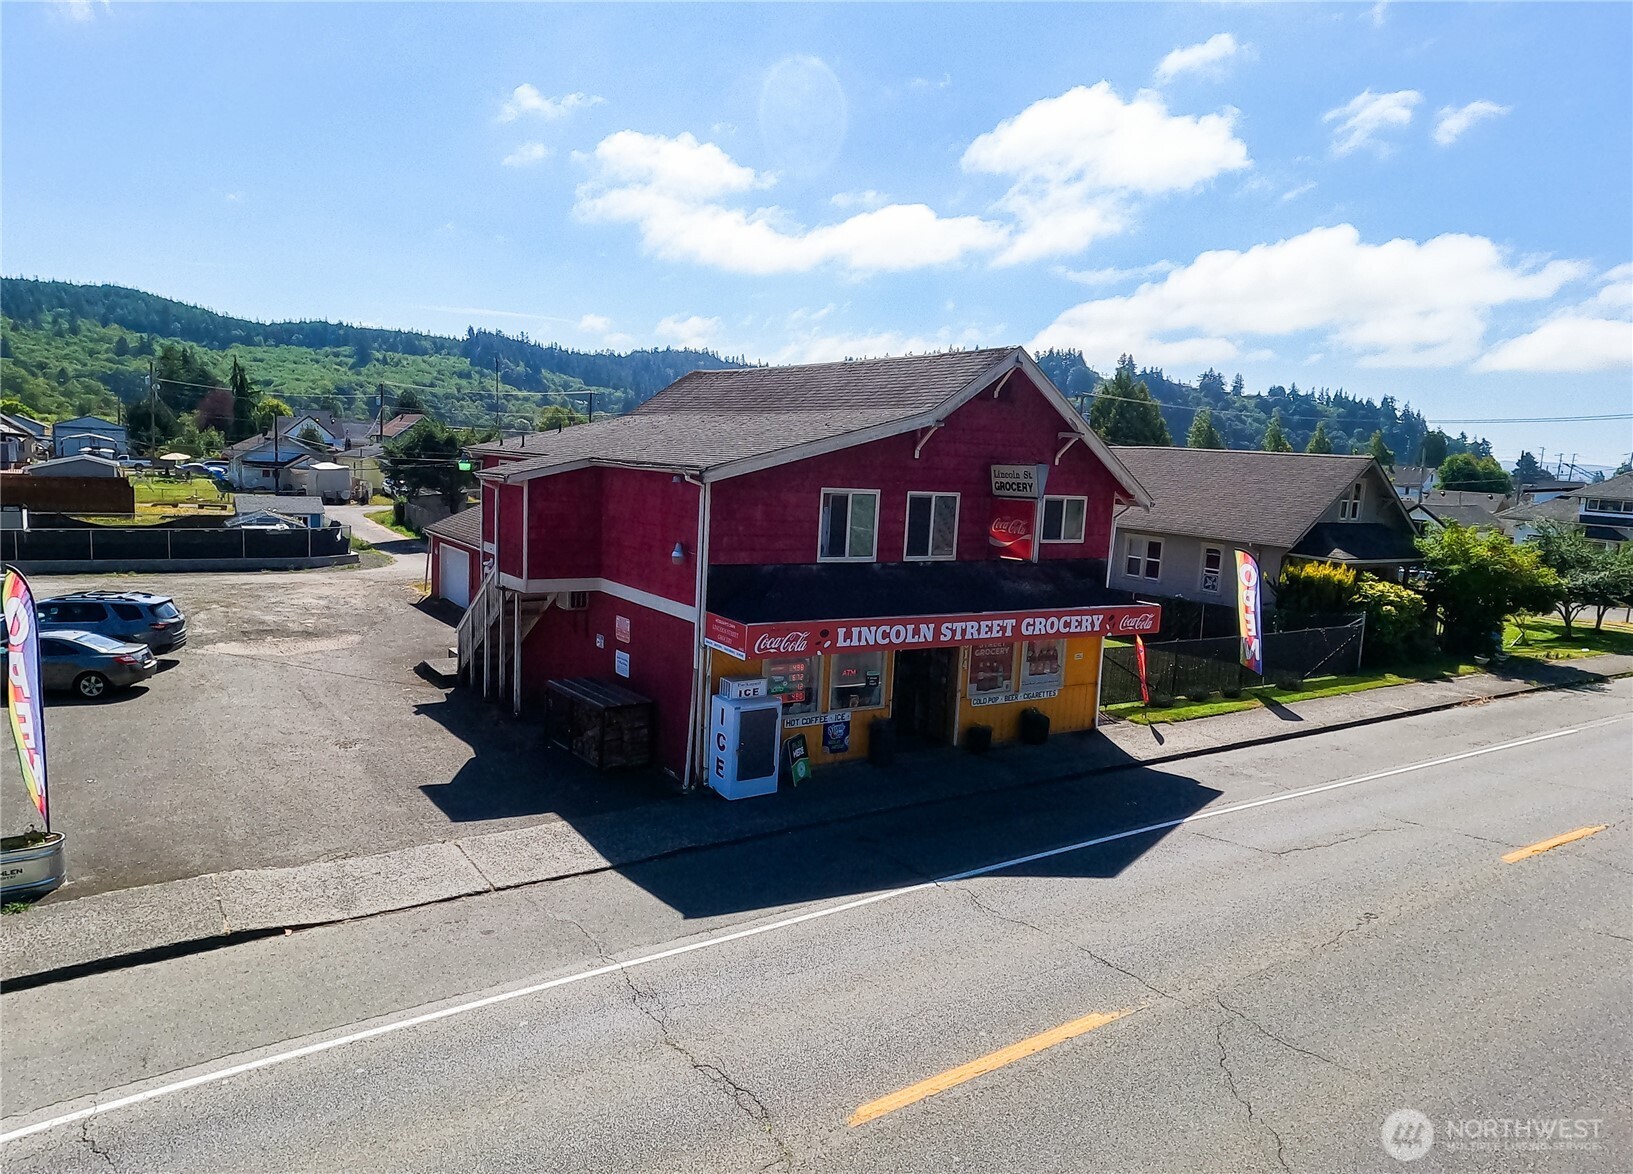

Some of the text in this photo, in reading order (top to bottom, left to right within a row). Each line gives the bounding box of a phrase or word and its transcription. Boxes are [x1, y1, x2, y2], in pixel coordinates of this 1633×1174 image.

[993, 469, 1020, 479] Lincoln
[994, 481, 1033, 492] GROCERY
[1119, 613, 1155, 631] Coca-Cola
[836, 614, 1104, 647] LINCOLN STREET GROCERY
[754, 631, 811, 654] Coca-Cola
[974, 647, 1010, 656] GROCERY
[738, 687, 759, 697] ICE
[972, 697, 987, 705] COLD
[1023, 690, 1056, 699] CIGARETTES
[785, 713, 846, 727] HOT COFFEE ICE
[715, 706, 727, 779] ICE
